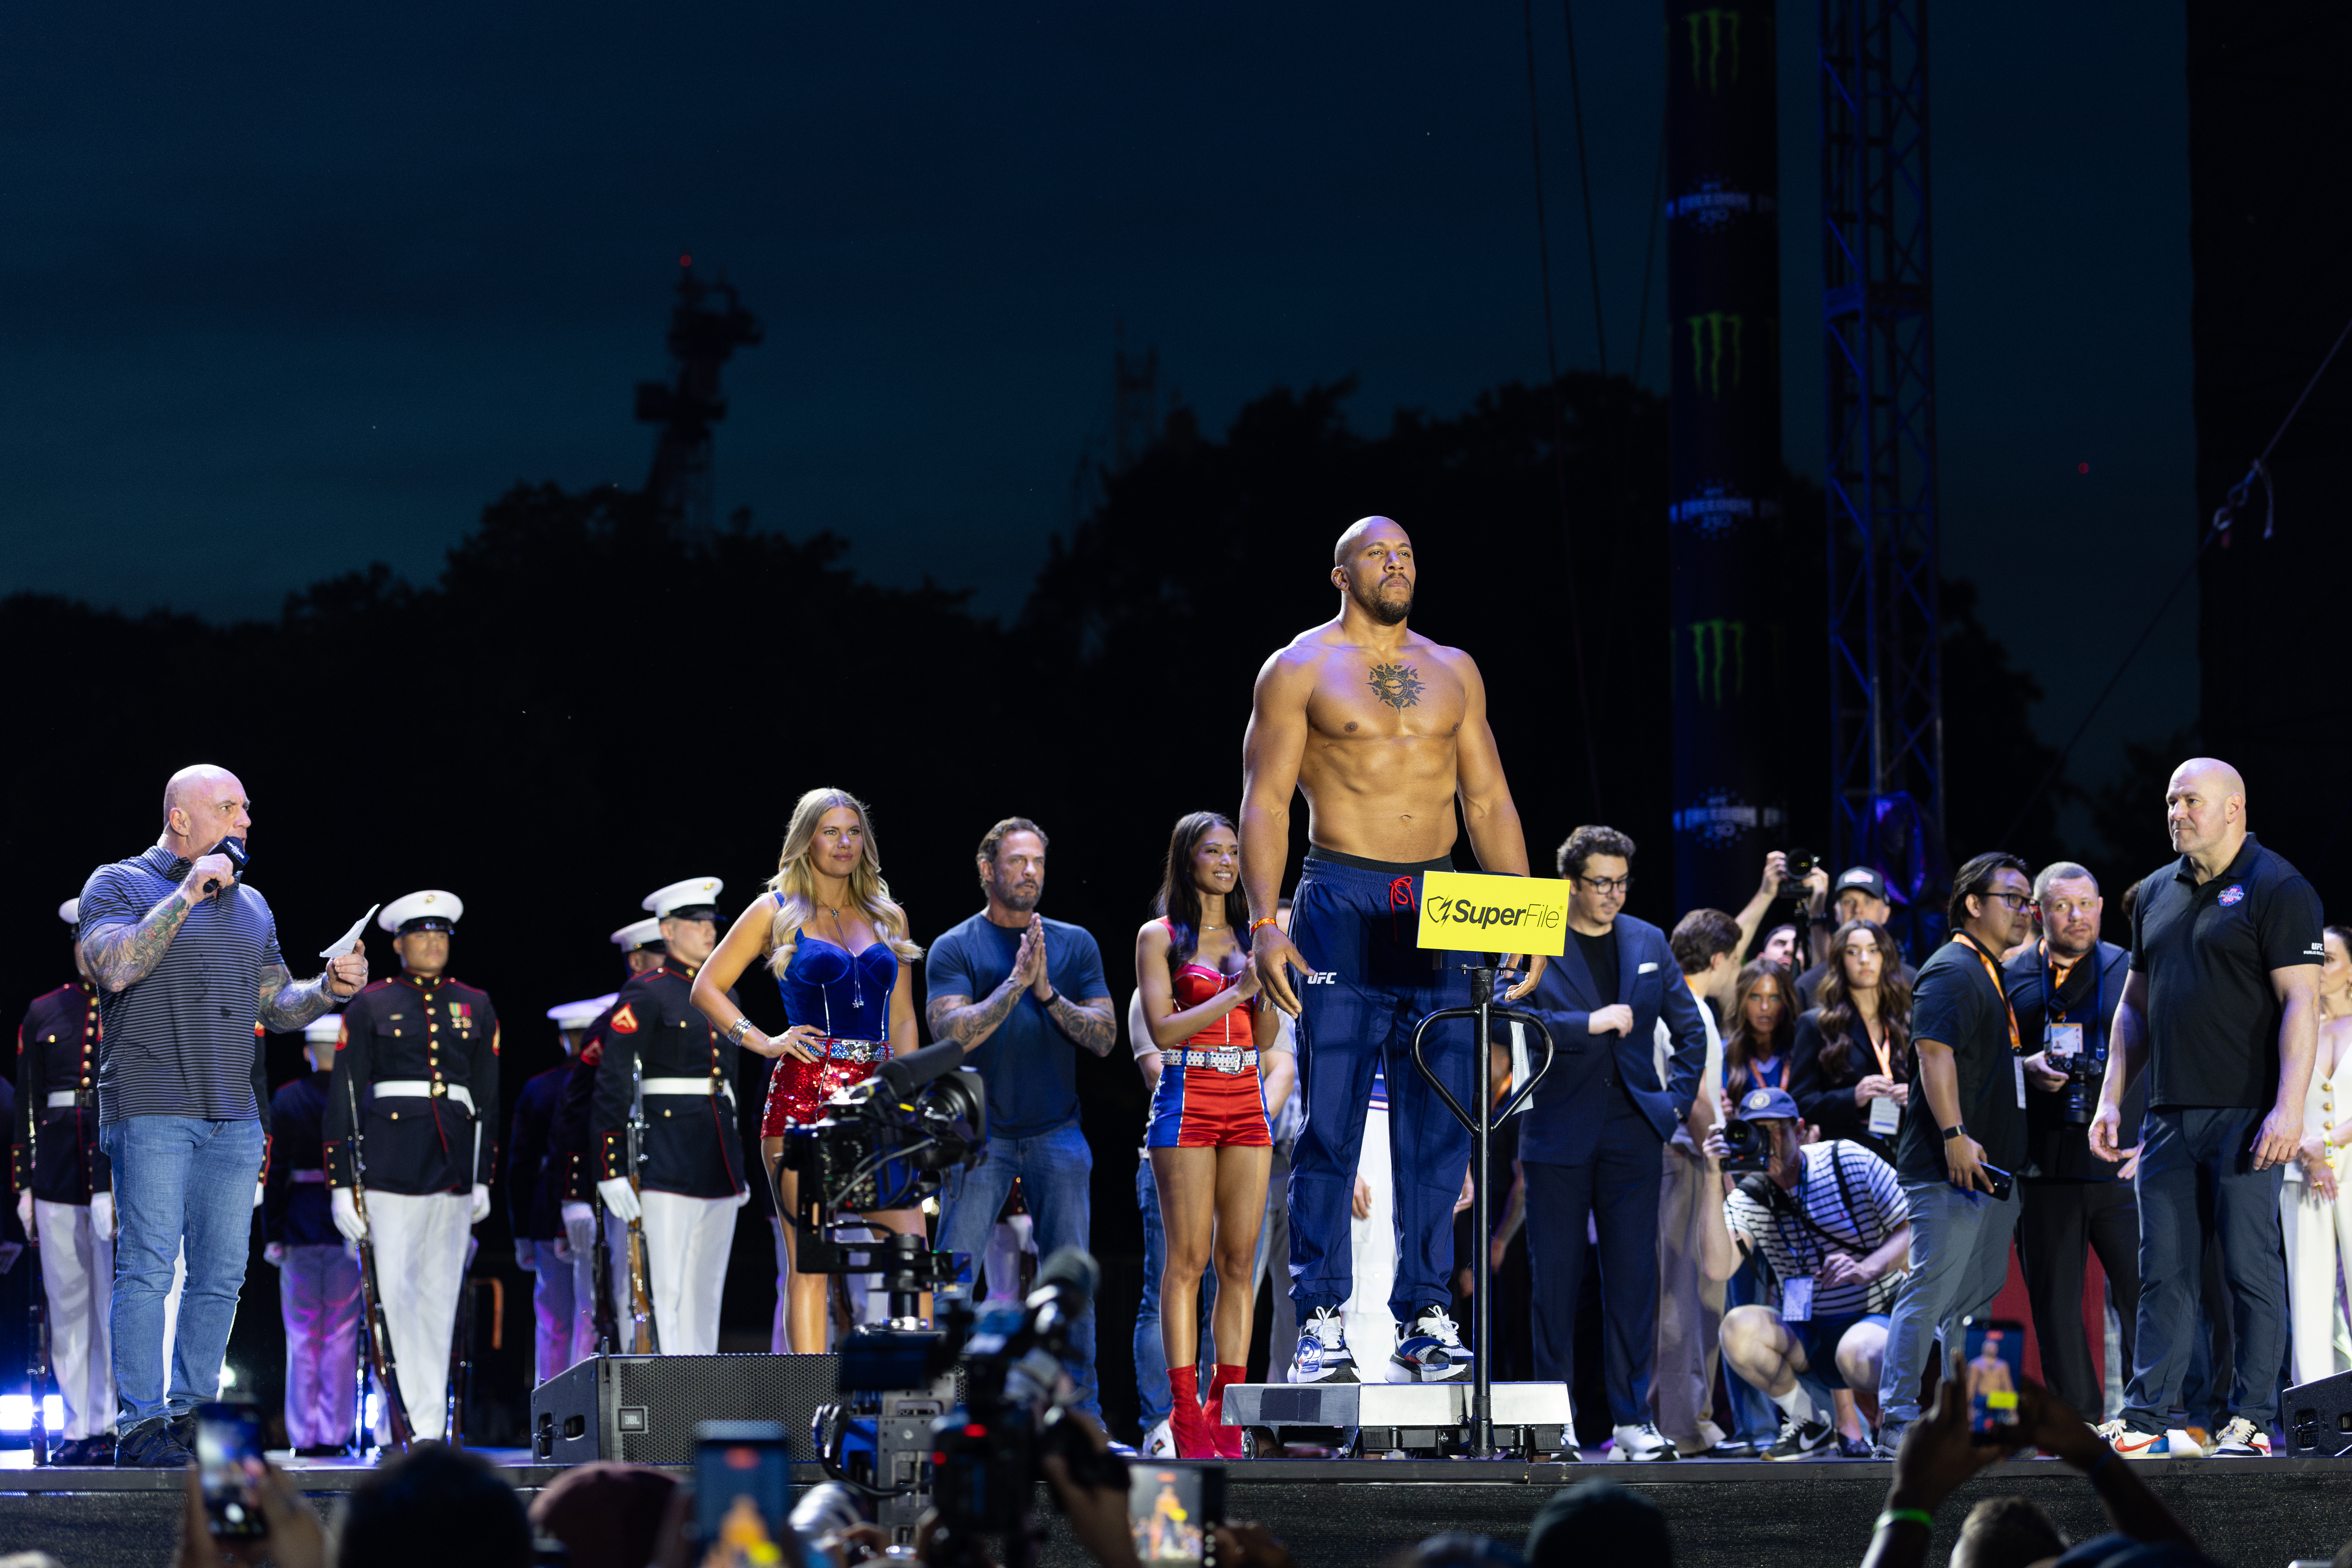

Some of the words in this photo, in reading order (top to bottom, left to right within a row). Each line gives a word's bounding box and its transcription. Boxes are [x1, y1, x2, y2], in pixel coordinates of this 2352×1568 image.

[1452, 899, 1559, 929] SuperFile
[2311, 942, 2323, 951] UFC
[1307, 972, 1337, 984] UFC
[624, 1415, 640, 1425] JBL
